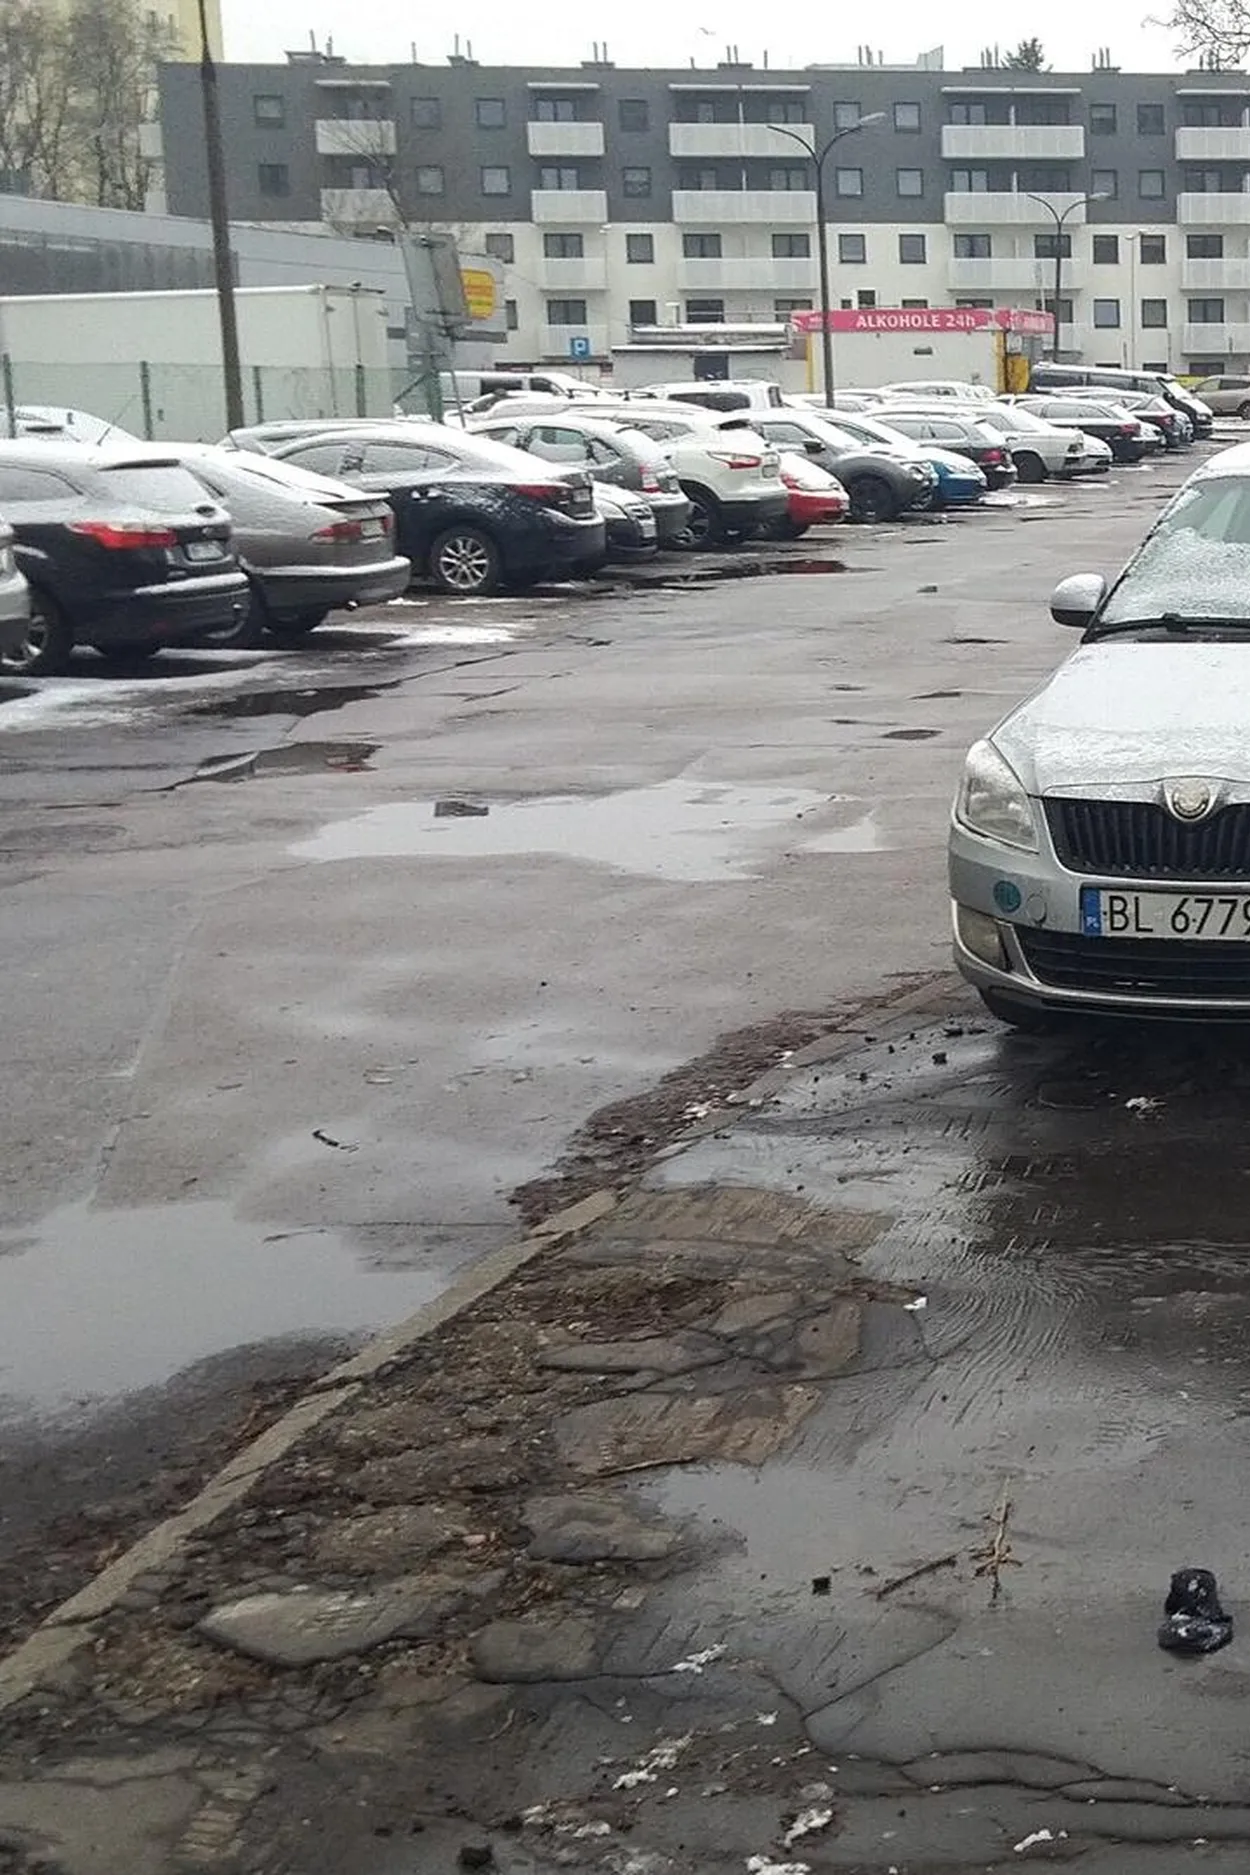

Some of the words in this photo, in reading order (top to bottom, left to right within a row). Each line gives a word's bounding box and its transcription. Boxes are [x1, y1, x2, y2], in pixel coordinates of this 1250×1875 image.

[857, 314, 941, 328] ALKOHOLE
[945, 314, 976, 328] 24h
[574, 340, 587, 356] P
[1109, 895, 1154, 932] BL
